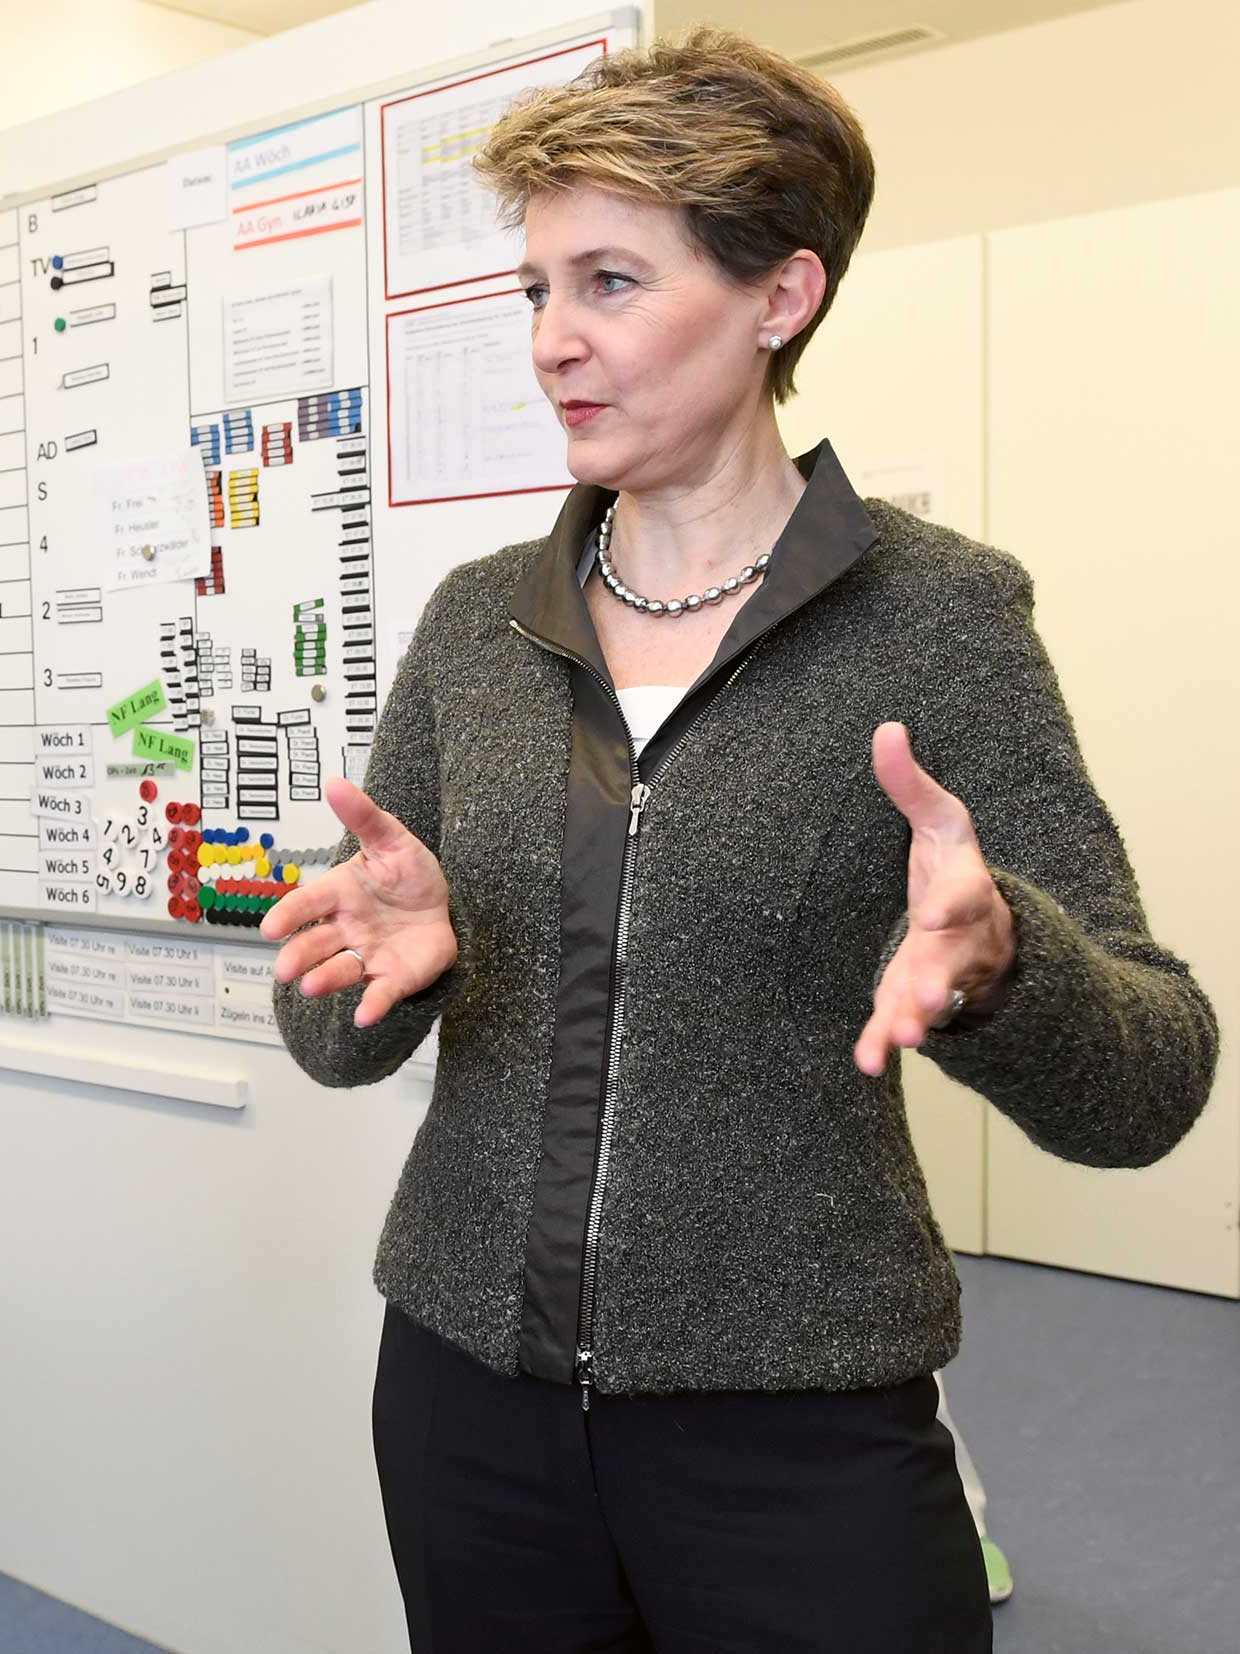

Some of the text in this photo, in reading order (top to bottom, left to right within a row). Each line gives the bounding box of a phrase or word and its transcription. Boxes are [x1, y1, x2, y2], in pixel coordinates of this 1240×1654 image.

[28, 213, 39, 233] B
[30, 256, 51, 277] TV
[33, 337, 39, 355] 1
[37, 441, 58, 461] AD
[38, 481, 48, 501] S
[39, 535, 49, 553] 4
[42, 601, 51, 620] 2
[43, 668, 53, 687] 3
[111, 690, 160, 726] NF Lang
[41, 732, 85, 747] Wöch 1
[139, 732, 189, 764] NF Lang
[42, 764, 87, 780] Wöch 2
[38, 794, 82, 814] Wöch 3
[137, 806, 148, 826] 3
[46, 827, 90, 842] Wöch 4
[104, 820, 113, 836] 1
[121, 825, 135, 845] 2
[153, 827, 162, 845] 4
[46, 859, 89, 874] Wöch 5
[140, 849, 149, 869] 7
[96, 873, 110, 889] 5
[135, 876, 147, 895] 8
[46, 887, 89, 903] Wöch 6
[224, 961, 247, 975] Visite
